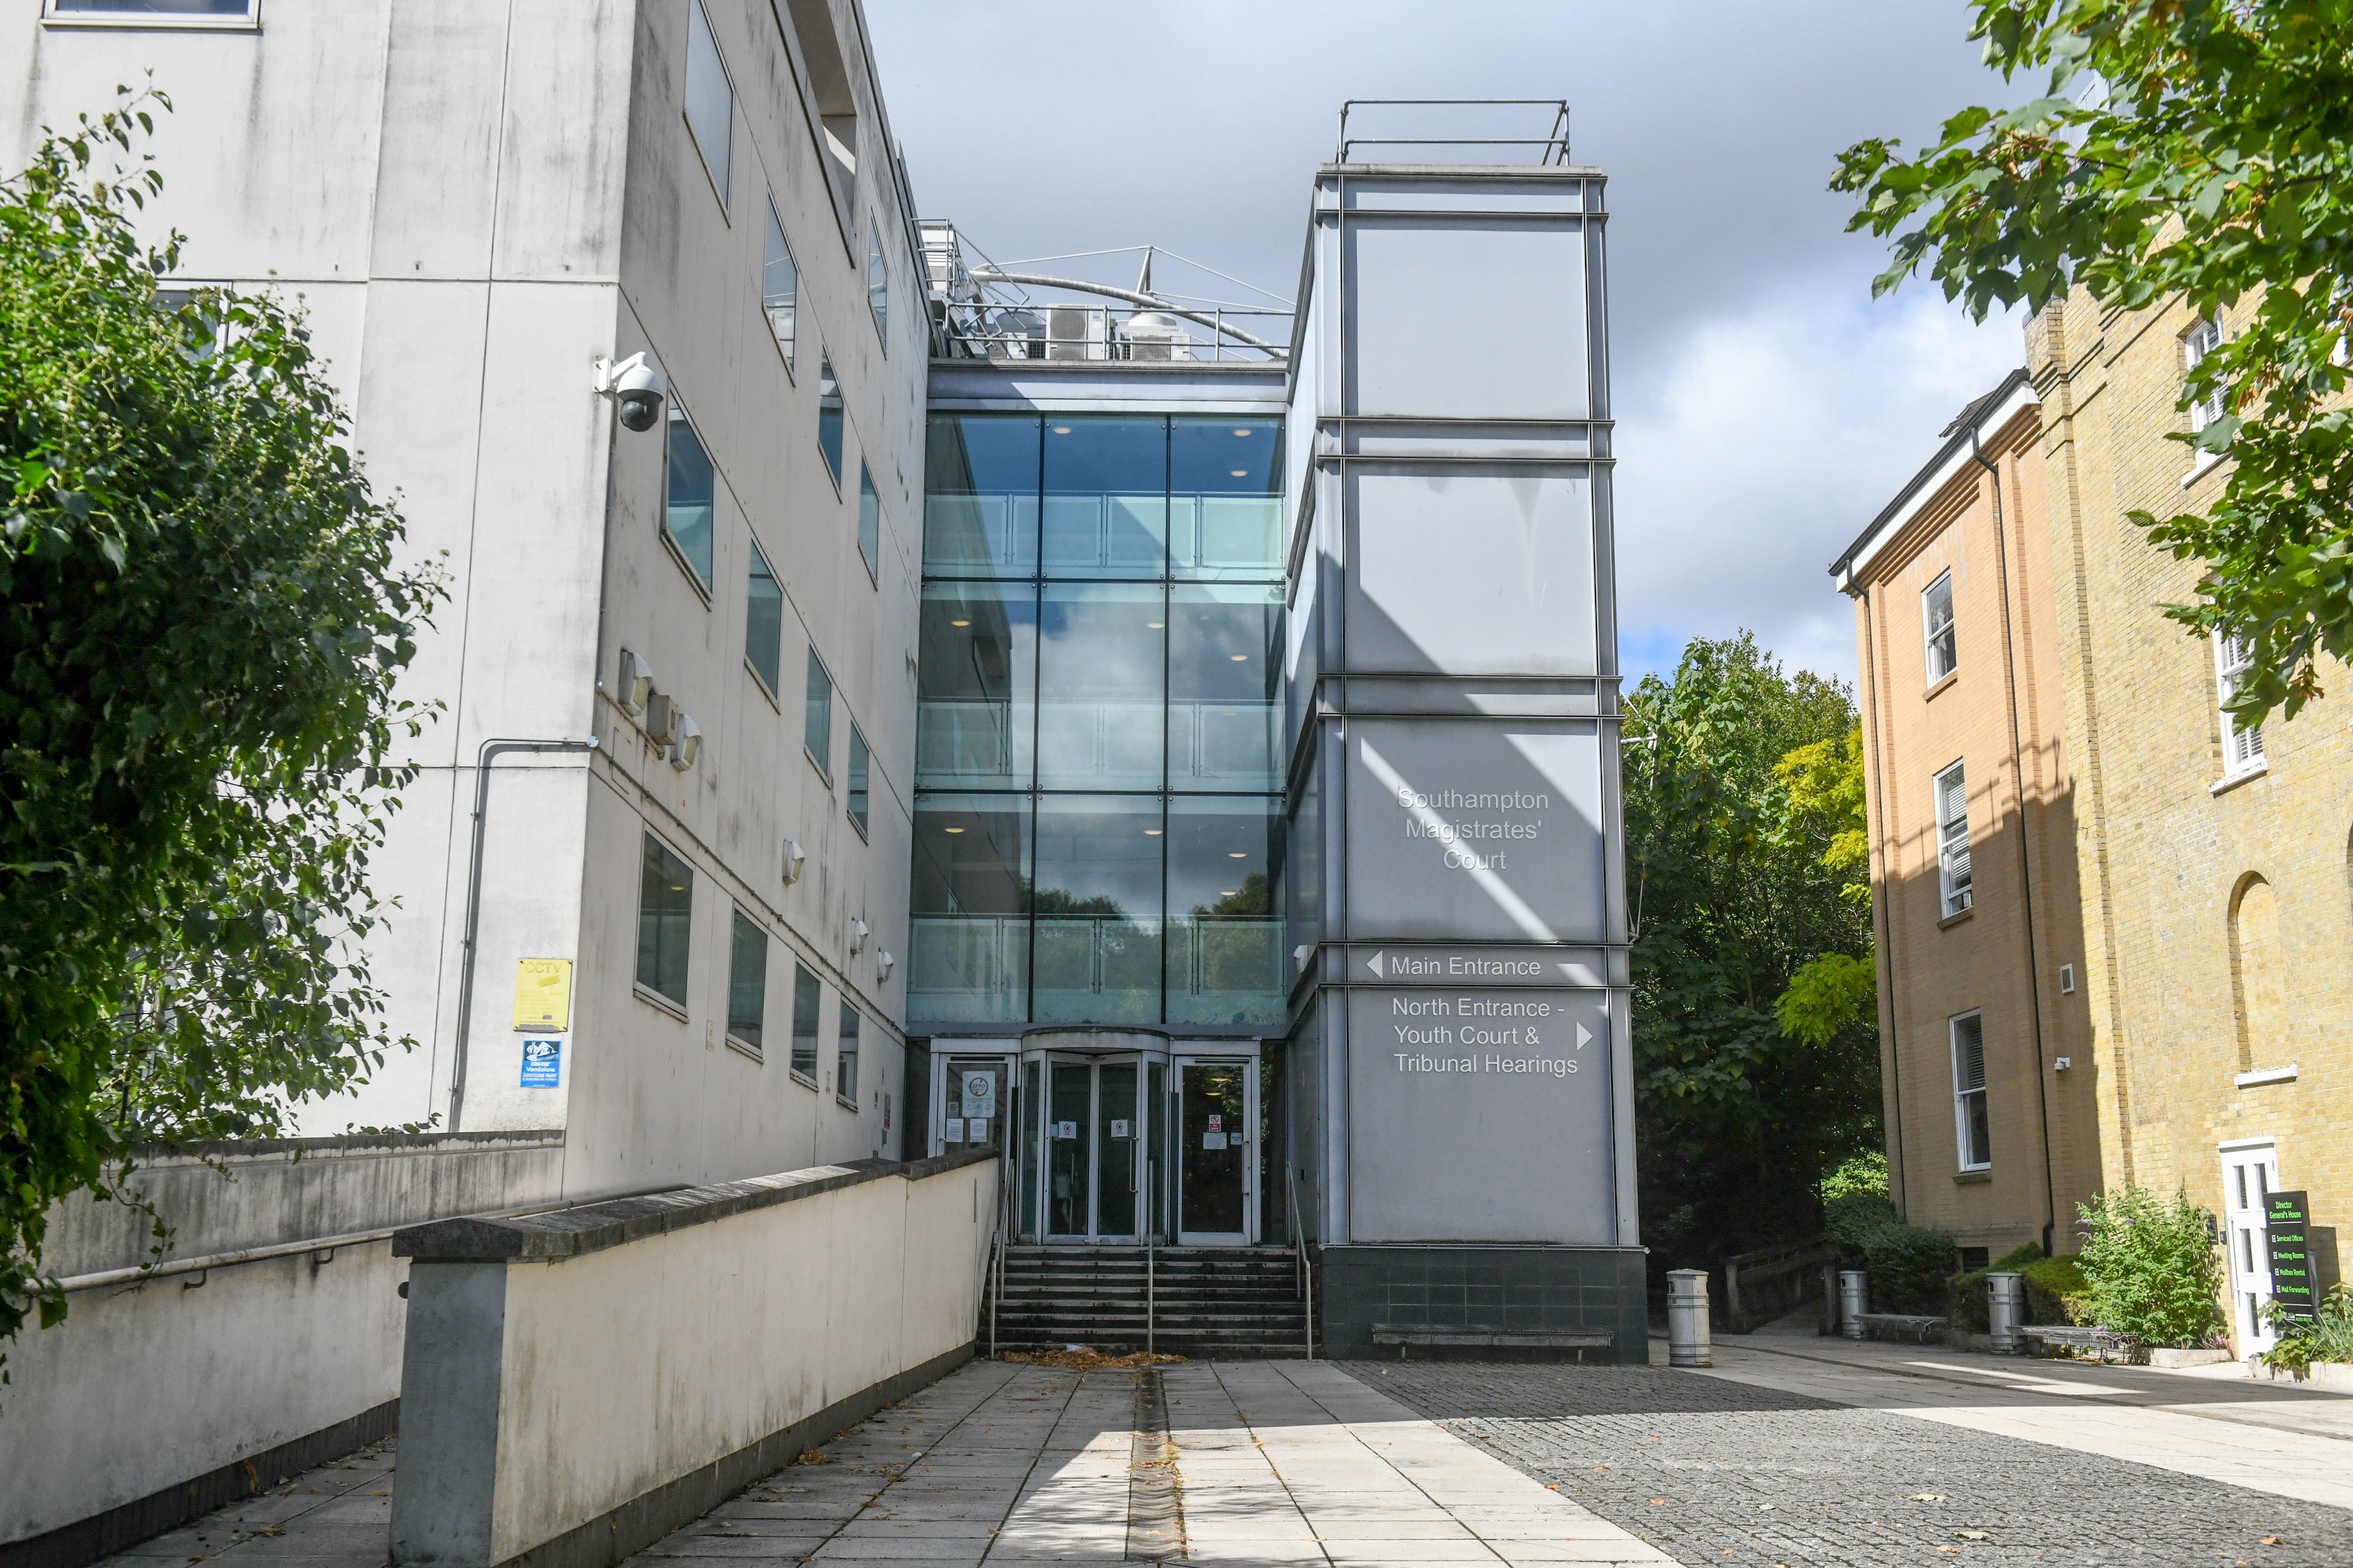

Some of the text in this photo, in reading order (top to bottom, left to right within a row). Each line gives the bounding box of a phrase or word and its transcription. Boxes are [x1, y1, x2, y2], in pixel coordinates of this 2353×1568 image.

[1398, 788, 1549, 813] Southampton
[1406, 819, 1542, 843] Magistrates'
[1443, 850, 1507, 870] Court
[524, 962, 563, 973] CCTV
[1392, 957, 1541, 975] Main Entrance
[1392, 997, 1449, 1016] North
[1458, 998, 1550, 1017] Entrance
[1394, 1026, 1540, 1045] Youth Court &
[1394, 1054, 1579, 1077] Tribunal Hearings
[2276, 1201, 2292, 1209] Director
[2269, 1210, 2288, 1219] General's
[2278, 1252, 2292, 1260] Meeting
[2288, 1286, 2310, 1295] Forwarding
